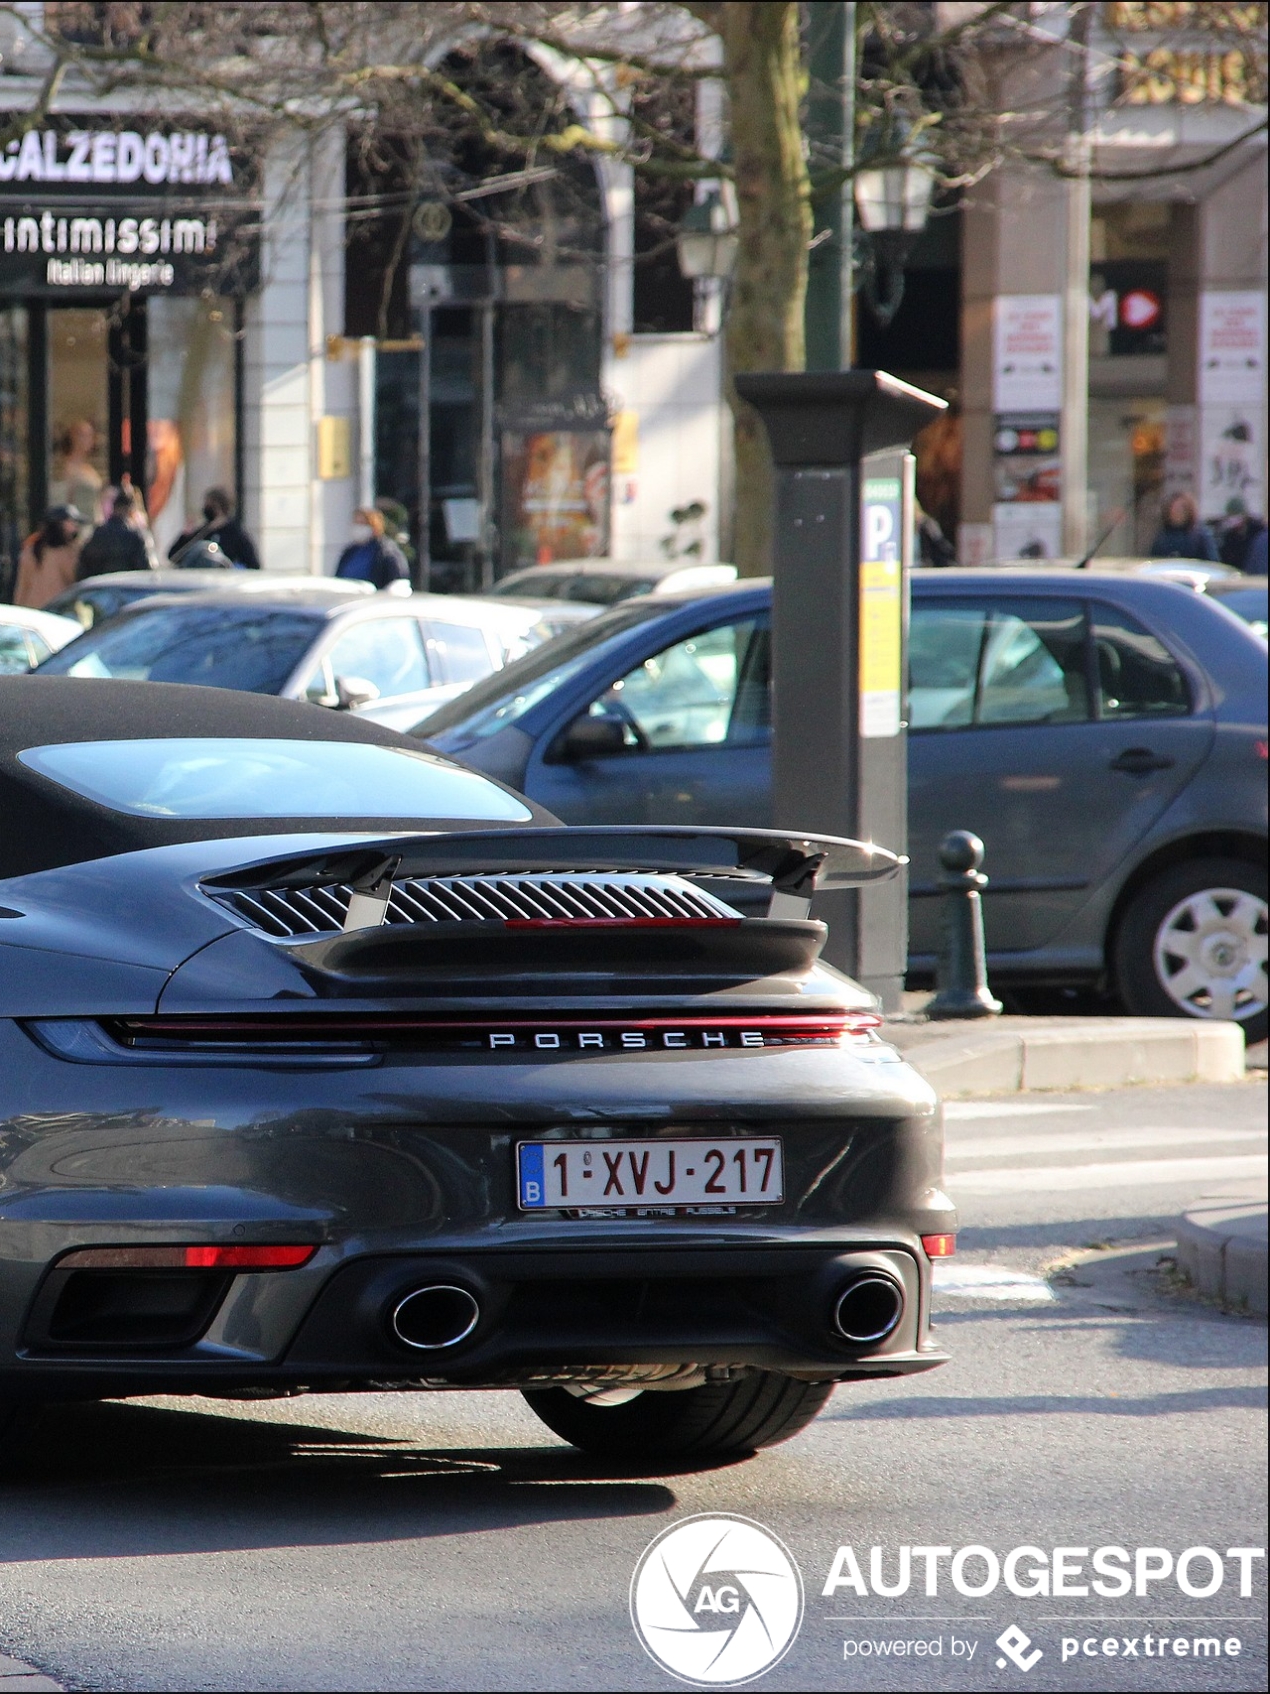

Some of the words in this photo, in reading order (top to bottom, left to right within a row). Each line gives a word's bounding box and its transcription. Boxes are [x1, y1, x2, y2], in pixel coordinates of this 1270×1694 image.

[47, 257, 105, 286] Italian
[105, 258, 175, 291] lingerie
[865, 504, 893, 560] P
[489, 1031, 765, 1049] PORSCHE
[553, 1148, 776, 1197] 1-XVJ-217
[525, 1180, 541, 1202] B
